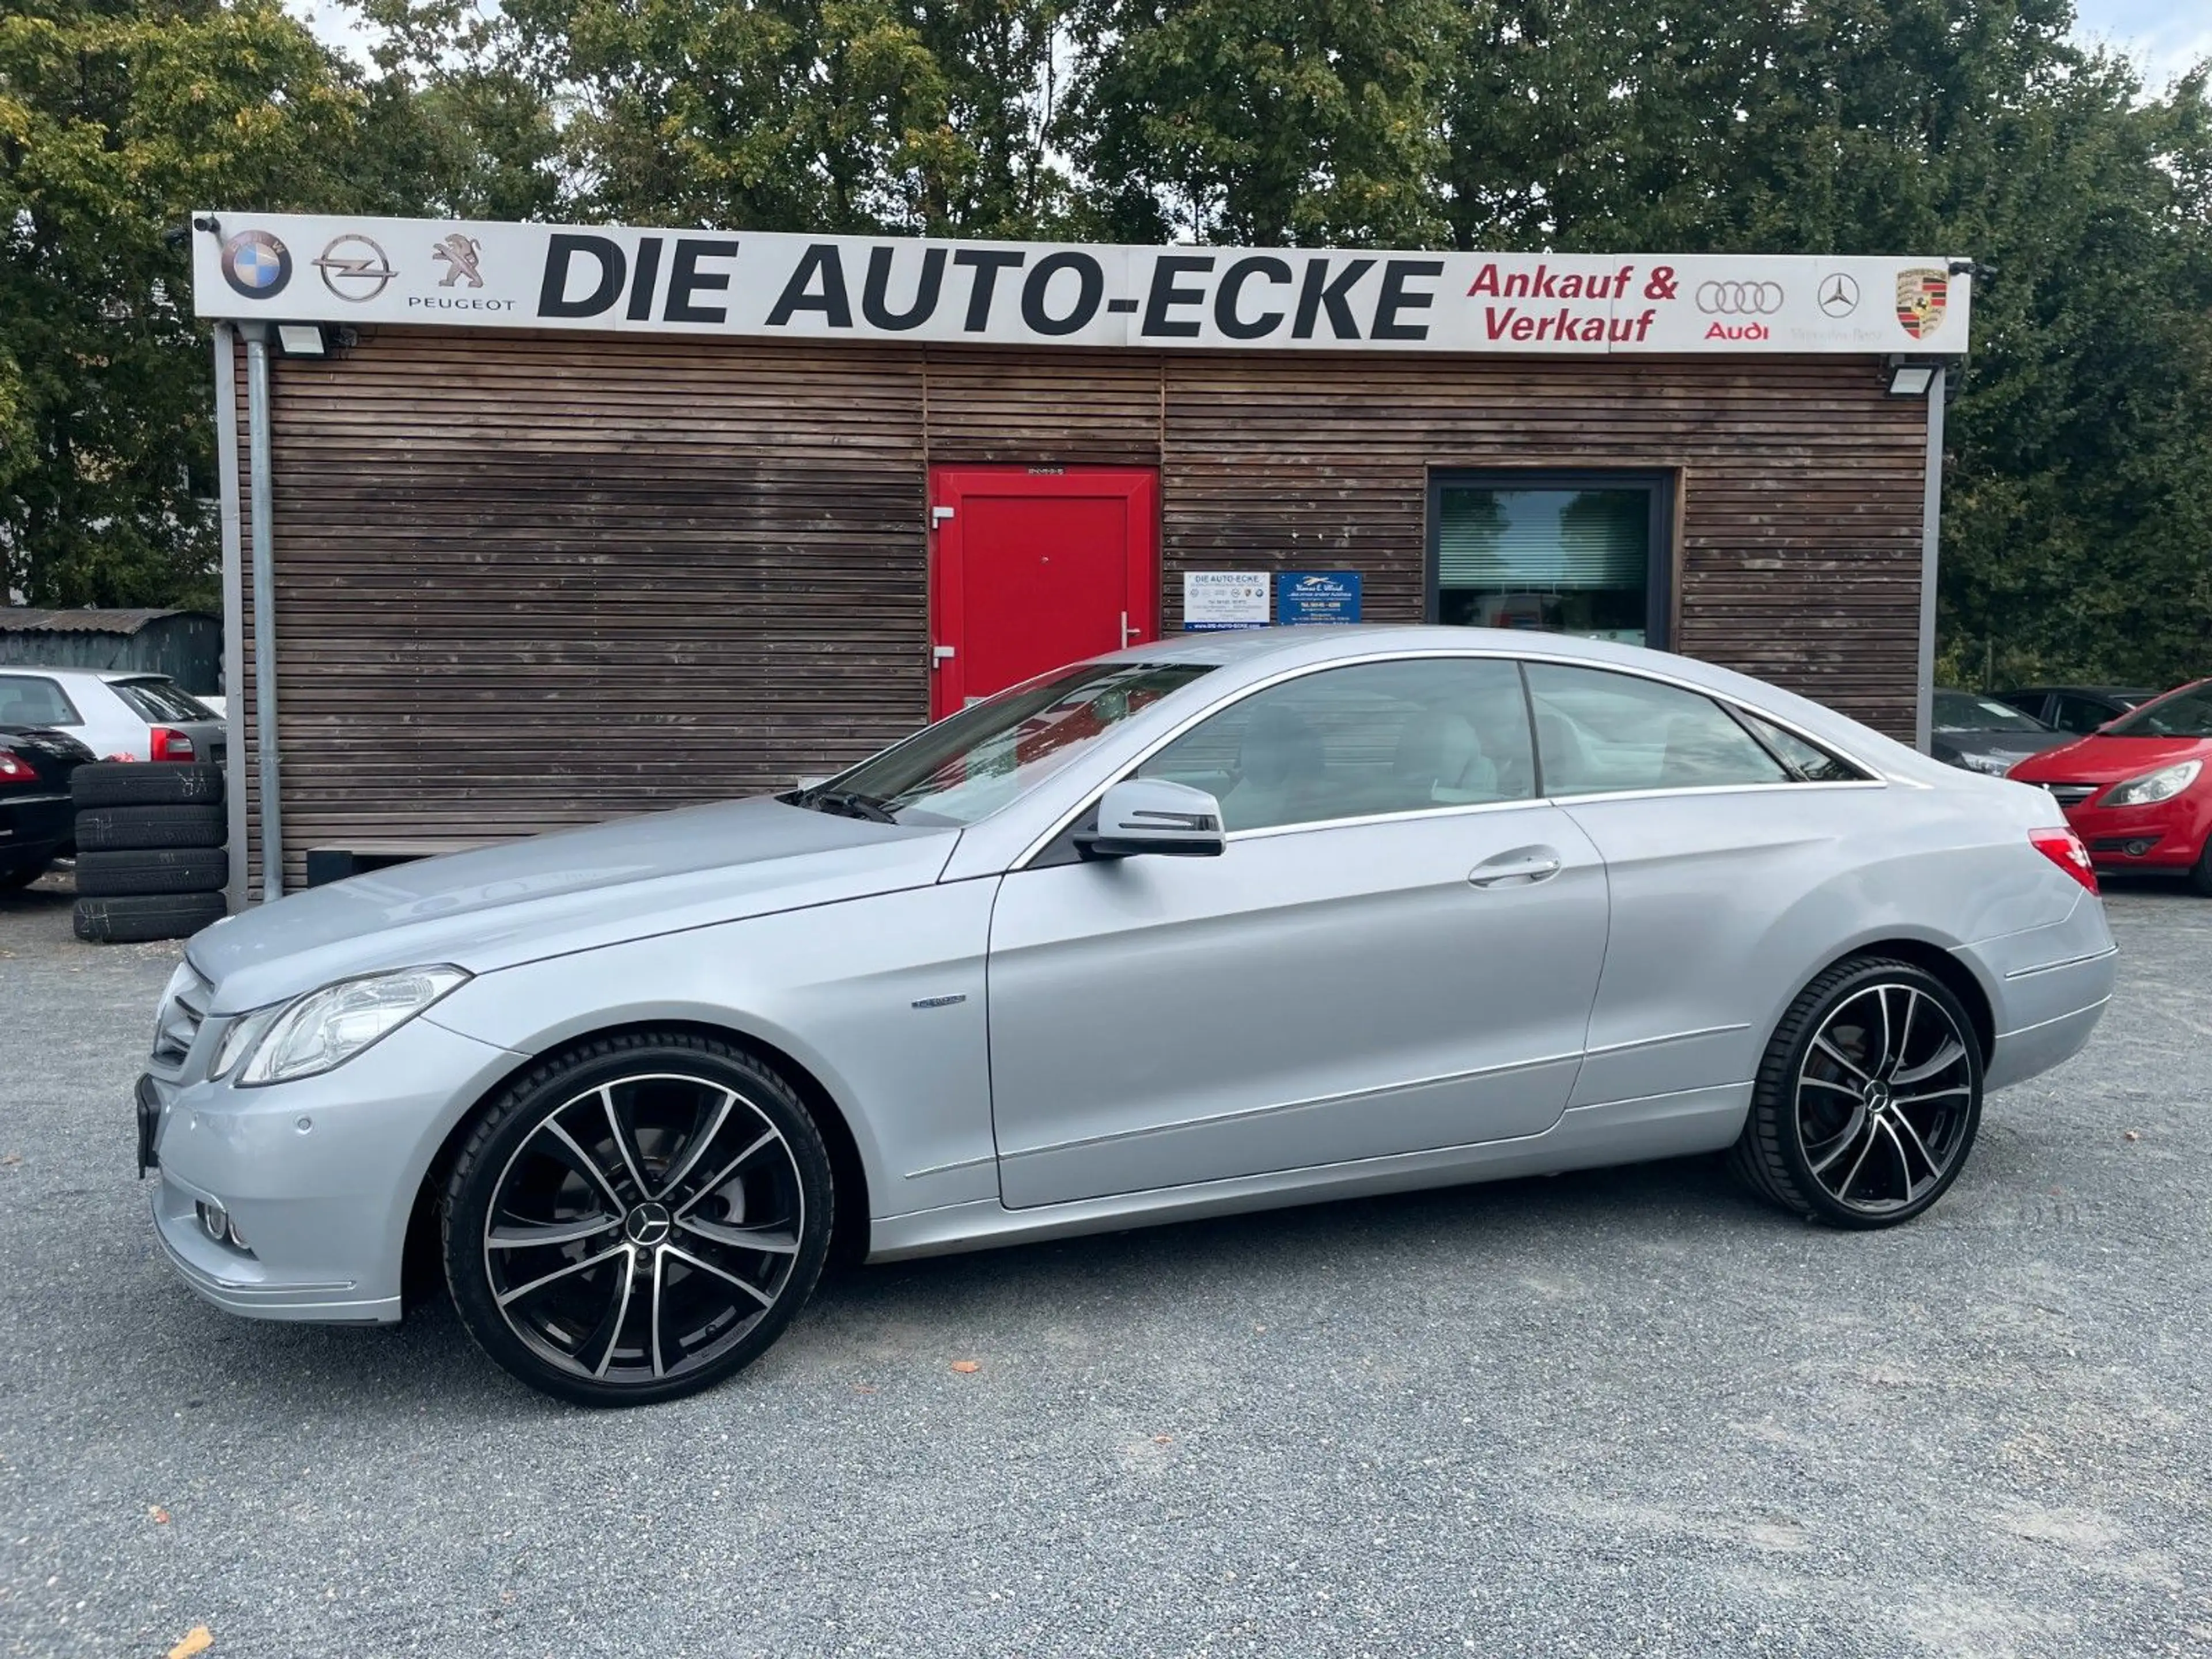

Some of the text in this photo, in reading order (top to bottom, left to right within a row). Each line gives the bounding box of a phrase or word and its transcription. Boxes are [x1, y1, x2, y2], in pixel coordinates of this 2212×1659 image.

[537, 233, 1445, 340] DIE AUTO-ECKE
[1467, 264, 1679, 300] Ankauf &
[408, 297, 517, 311] PEUGEOT
[1485, 308, 1656, 342] Verkauf
[1704, 321, 1770, 340] Audi
[1195, 575, 1209, 583] DIE
